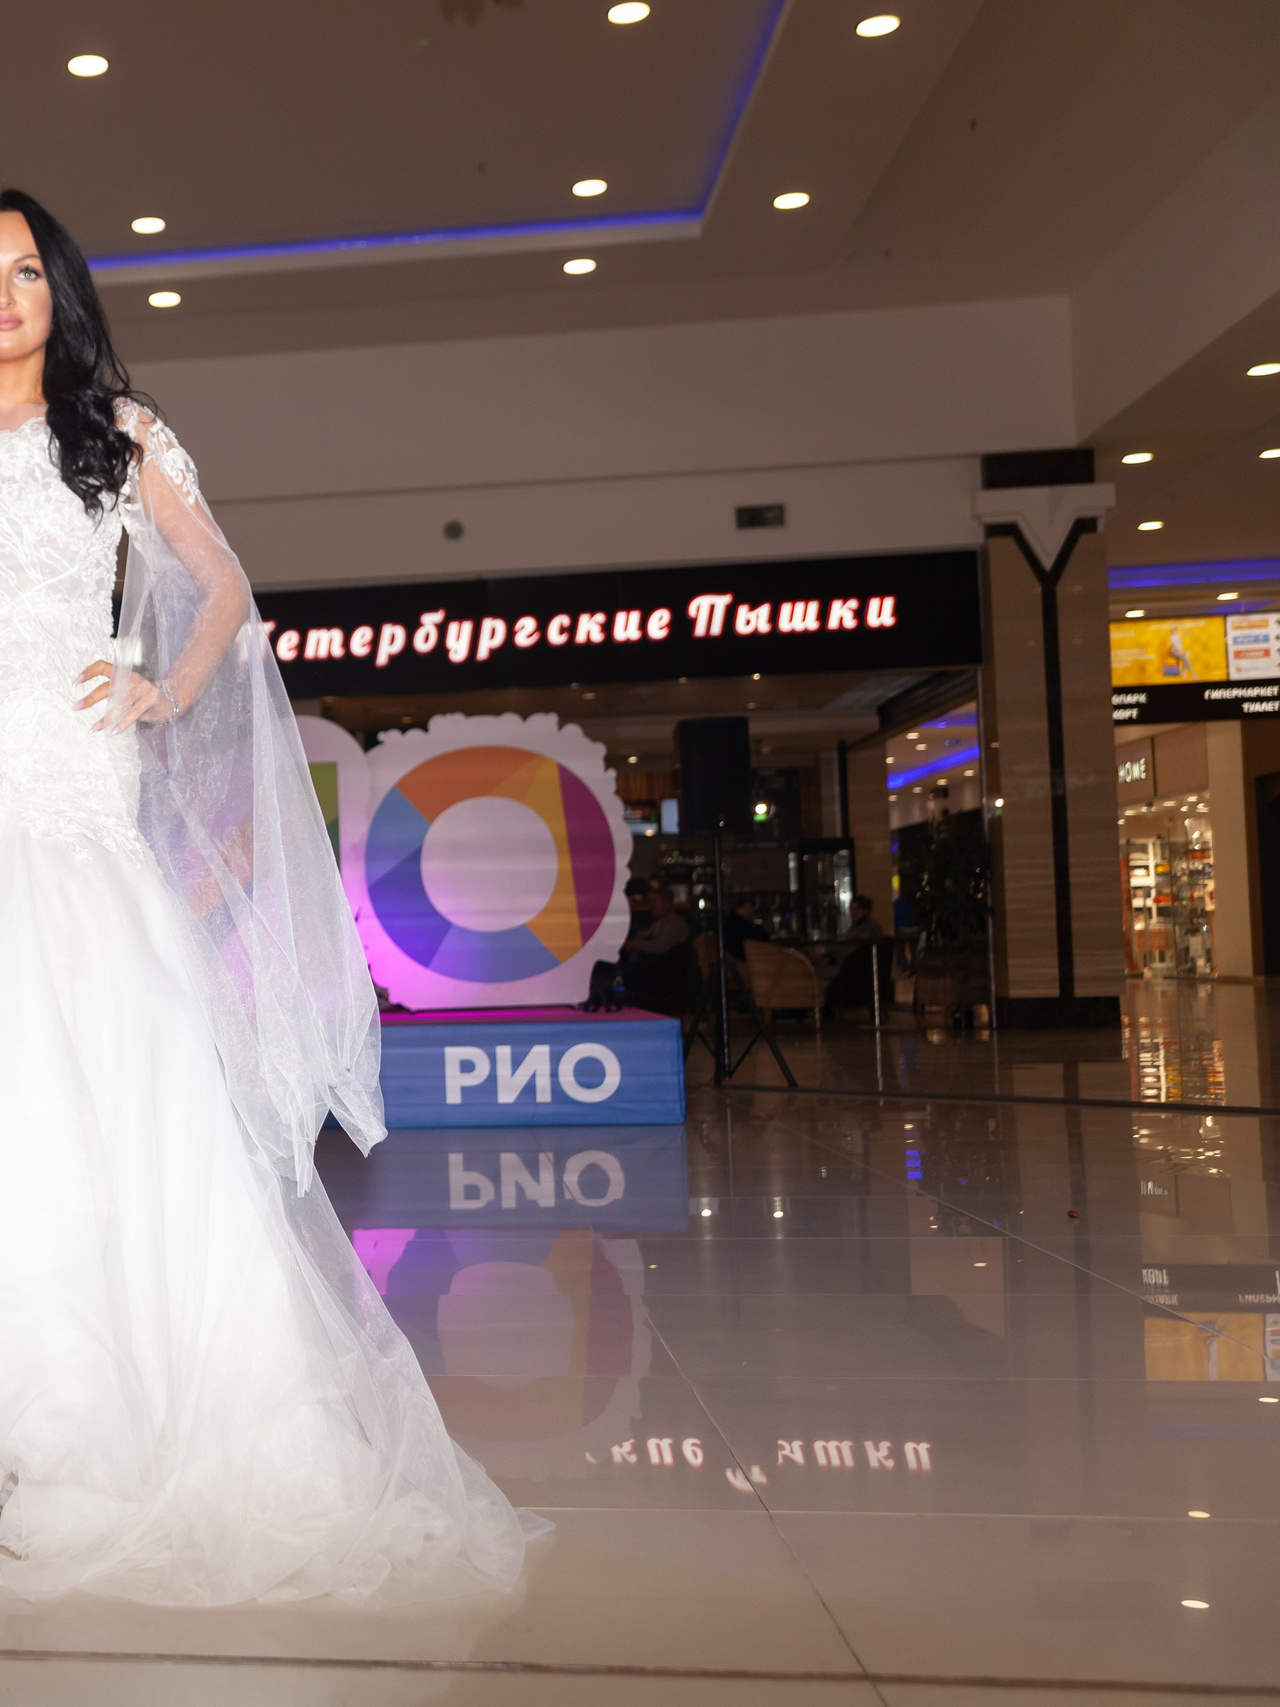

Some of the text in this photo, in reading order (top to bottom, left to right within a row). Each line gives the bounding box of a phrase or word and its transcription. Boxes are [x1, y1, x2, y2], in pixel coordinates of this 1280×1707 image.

[687, 592, 898, 638] Пышки
[1203, 685, 1280, 700] ГИПЕРМАРКЕТ
[444, 1042, 622, 1104] РИО
